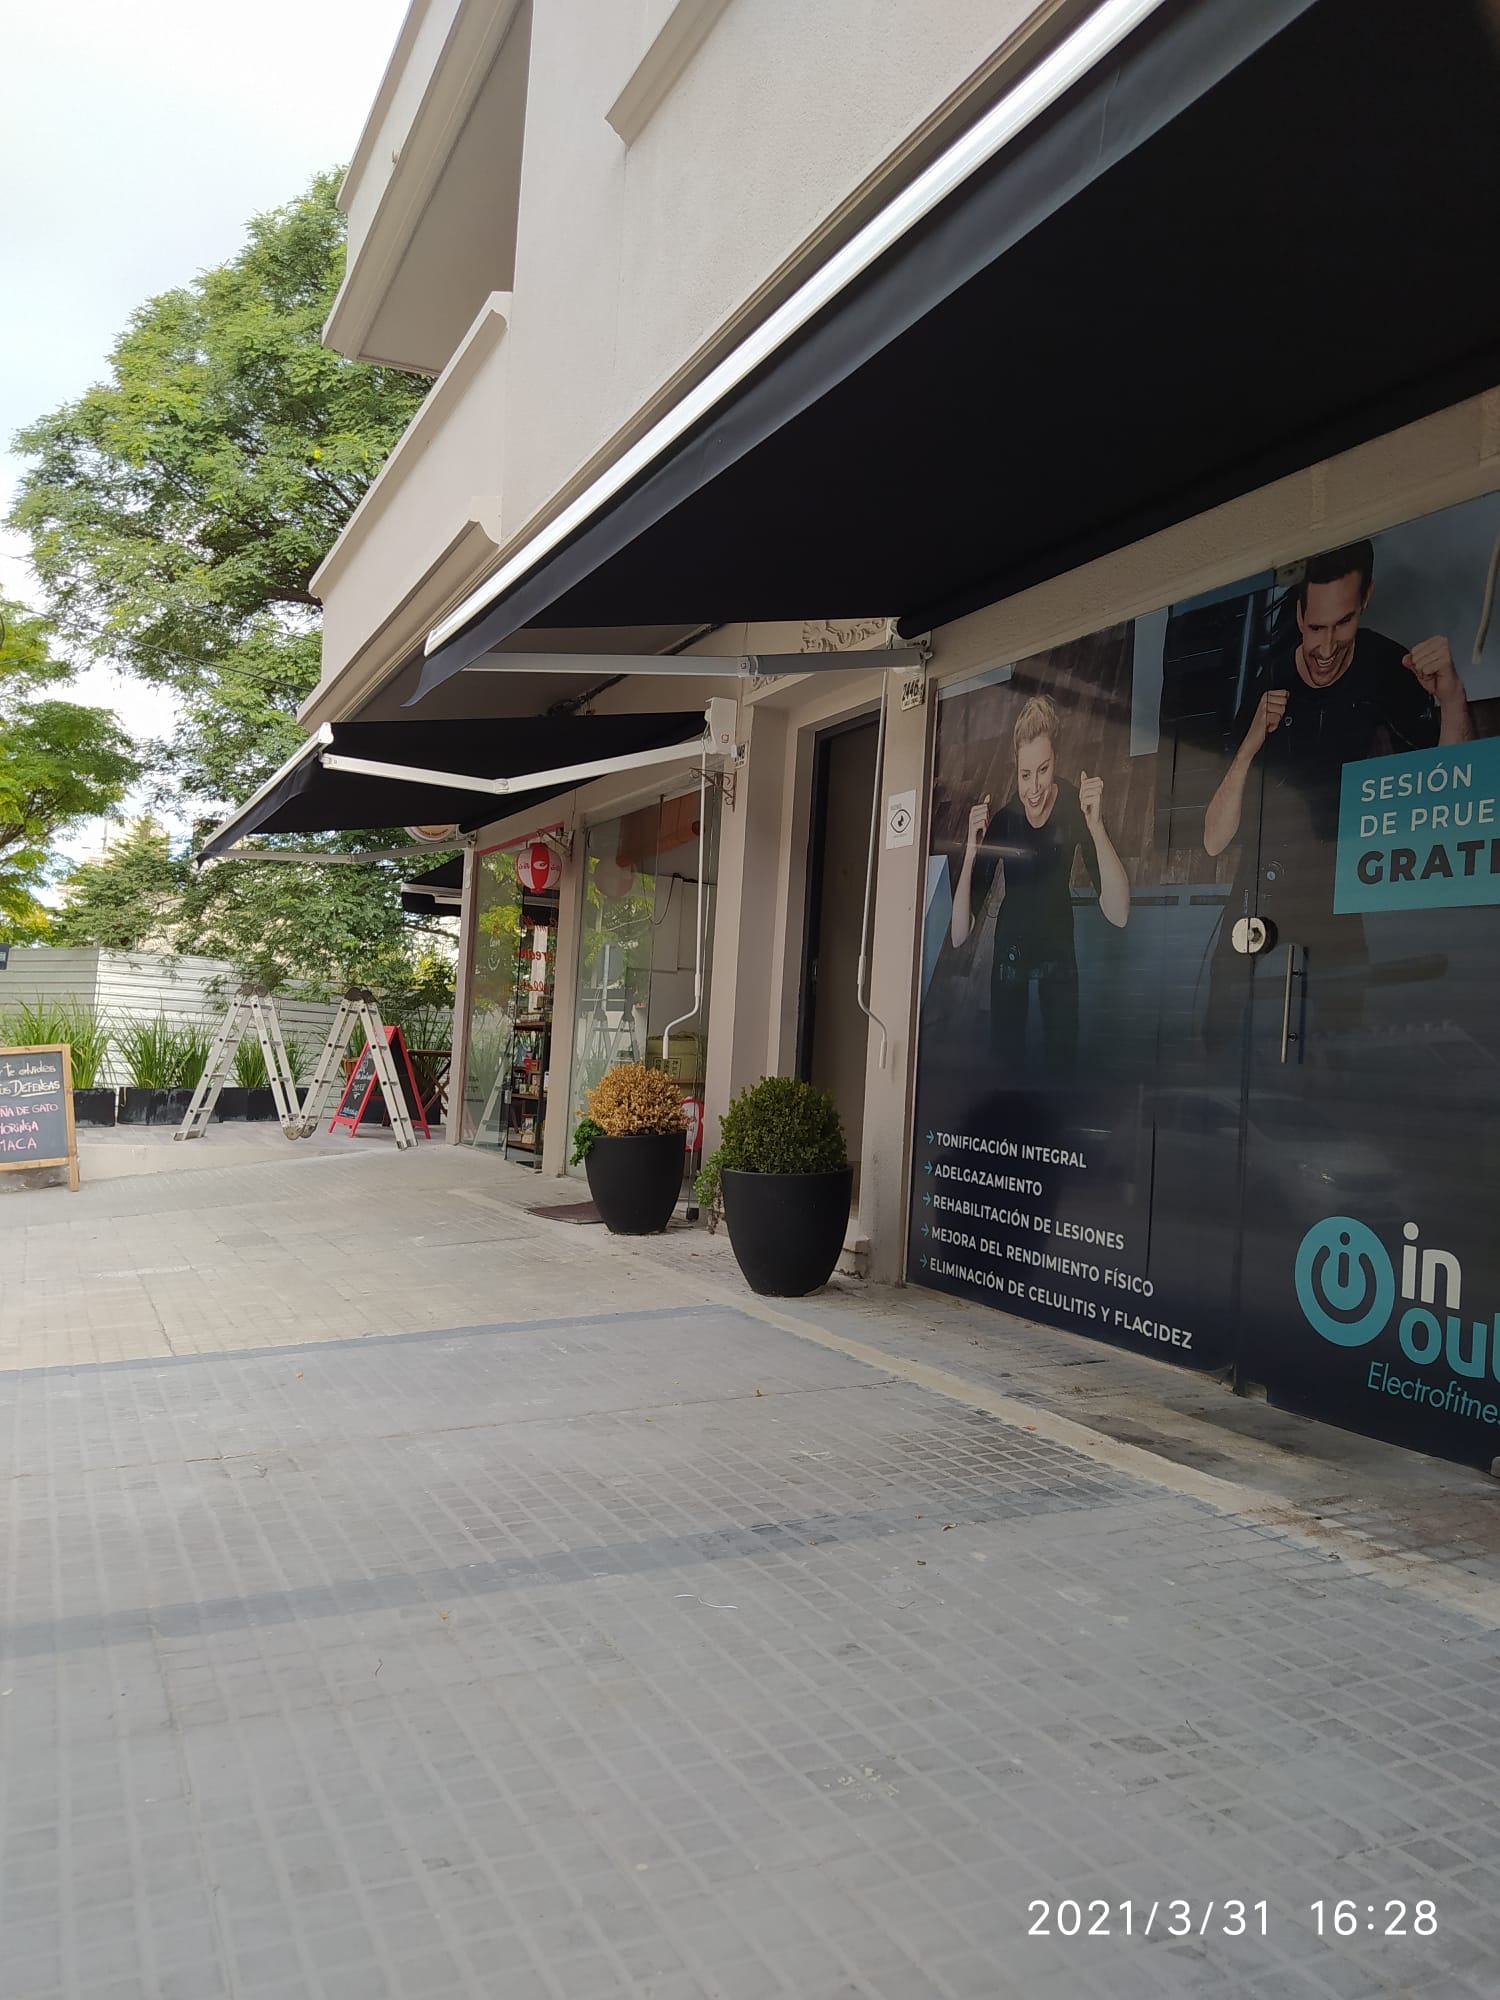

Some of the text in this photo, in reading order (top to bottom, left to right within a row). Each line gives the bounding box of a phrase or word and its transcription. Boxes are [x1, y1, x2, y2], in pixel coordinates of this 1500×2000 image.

[1361, 762, 1472, 802] SESIÓN
[1360, 799, 1495, 838] DE PRUE
[16, 1107, 30, 1115] DE
[32, 1103, 58, 1113] GATO
[936, 1132, 1087, 1168] TONIFICACIÓN INTEGRAL
[934, 1163, 1043, 1196] ADELGAZAMIENTO
[933, 1194, 1124, 1250] REHABILITACIÓN DE LESIONES
[931, 1226, 1154, 1297] MEJORA DEL RENDIMIENTO FÍSICO
[1401, 1221, 1462, 1310] in
[930, 1257, 1193, 1350] ELIMINACIÓN DE CELULITIS Y FLACIDEZ
[1367, 1361, 1500, 1426] Electrofitne
